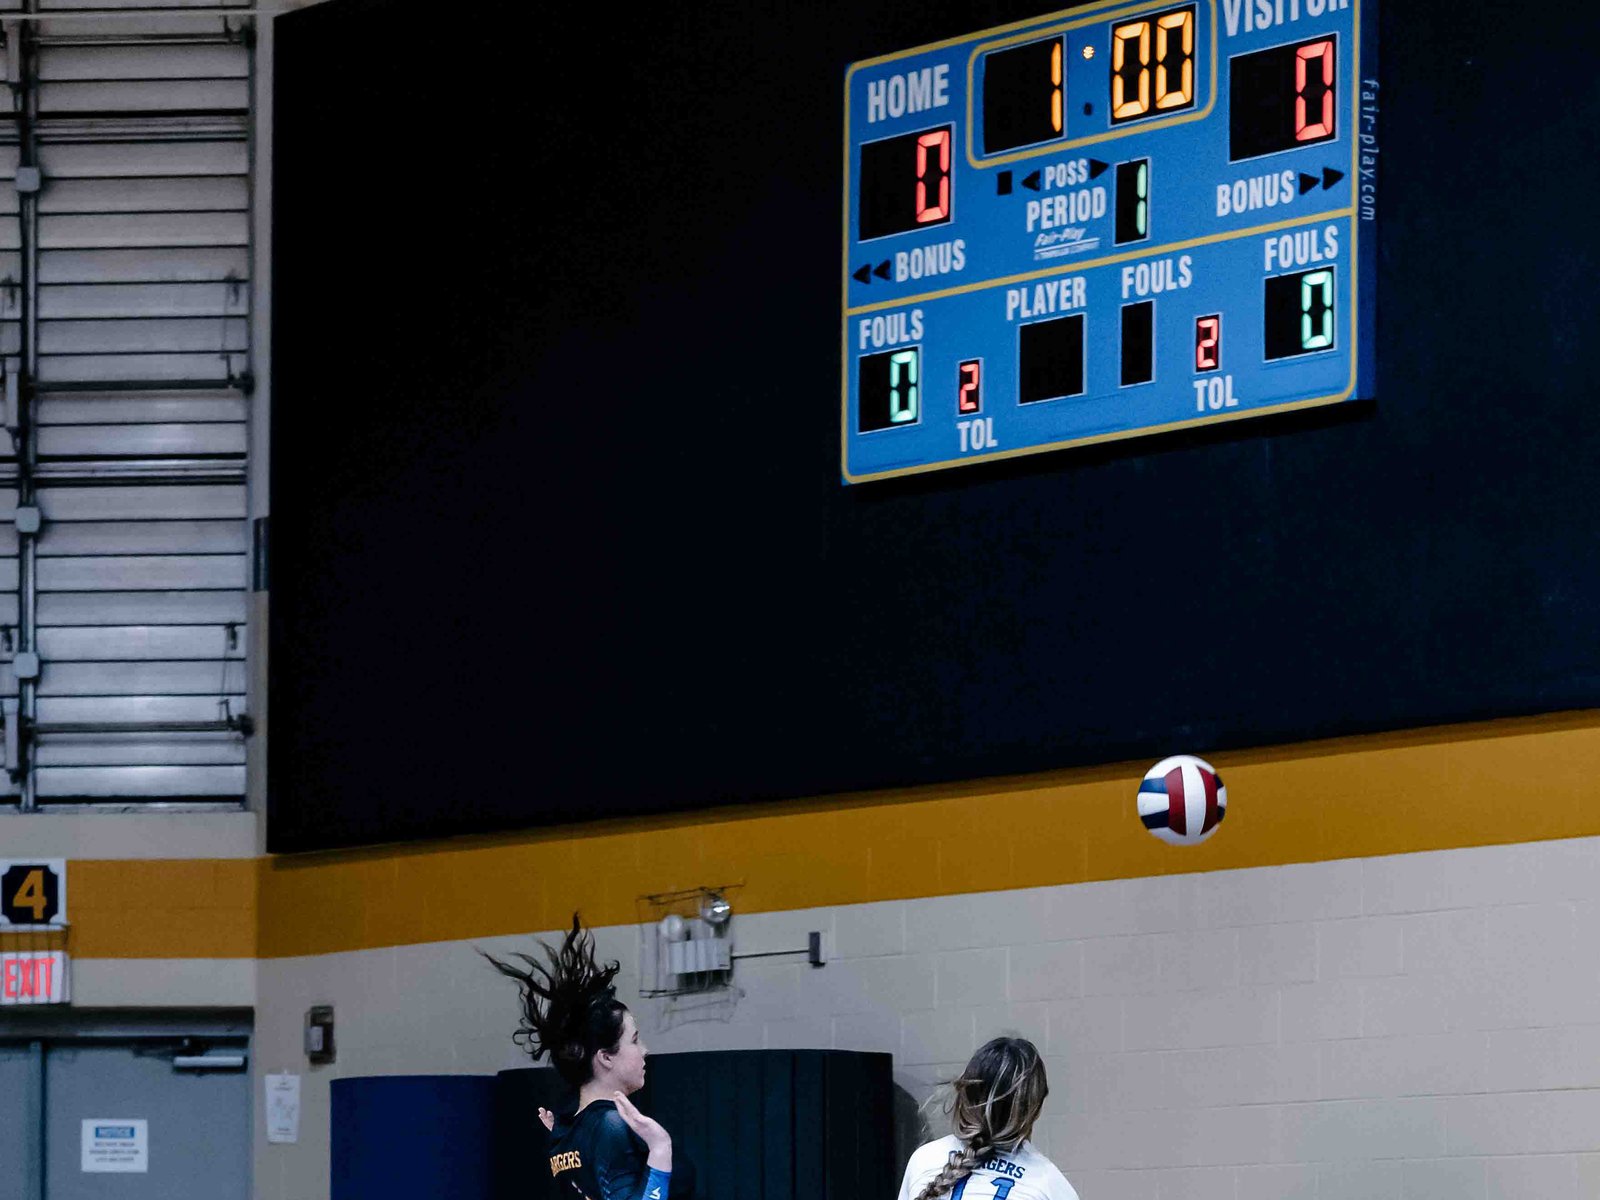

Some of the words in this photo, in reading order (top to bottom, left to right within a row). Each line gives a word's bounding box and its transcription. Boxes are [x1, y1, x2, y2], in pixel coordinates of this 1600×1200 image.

[1223, 0, 1348, 37] VISI
[867, 63, 950, 123] HOME
[1295, 41, 1333, 141] 0
[1359, 79, 1380, 221] fair-play.com
[916, 130, 950, 223] 0
[1045, 158, 1088, 190] POSS
[1216, 170, 1295, 217] BONUS
[1026, 186, 1106, 233] PERIOD
[1136, 163, 1147, 235] 1
[895, 239, 966, 282] BONUS
[1264, 225, 1339, 271] FOULS
[1006, 276, 1087, 320] PLAYER
[1121, 255, 1193, 299] FOULS
[859, 309, 924, 350] FOULS
[1301, 271, 1333, 350] 0
[1196, 318, 1218, 368] 2
[890, 350, 917, 423] 0
[960, 364, 979, 411] 2
[1193, 375, 1239, 412] TOL
[956, 417, 998, 452] TOL
[12, 869, 47, 920] 4
[4, 957, 56, 998] EXIT
